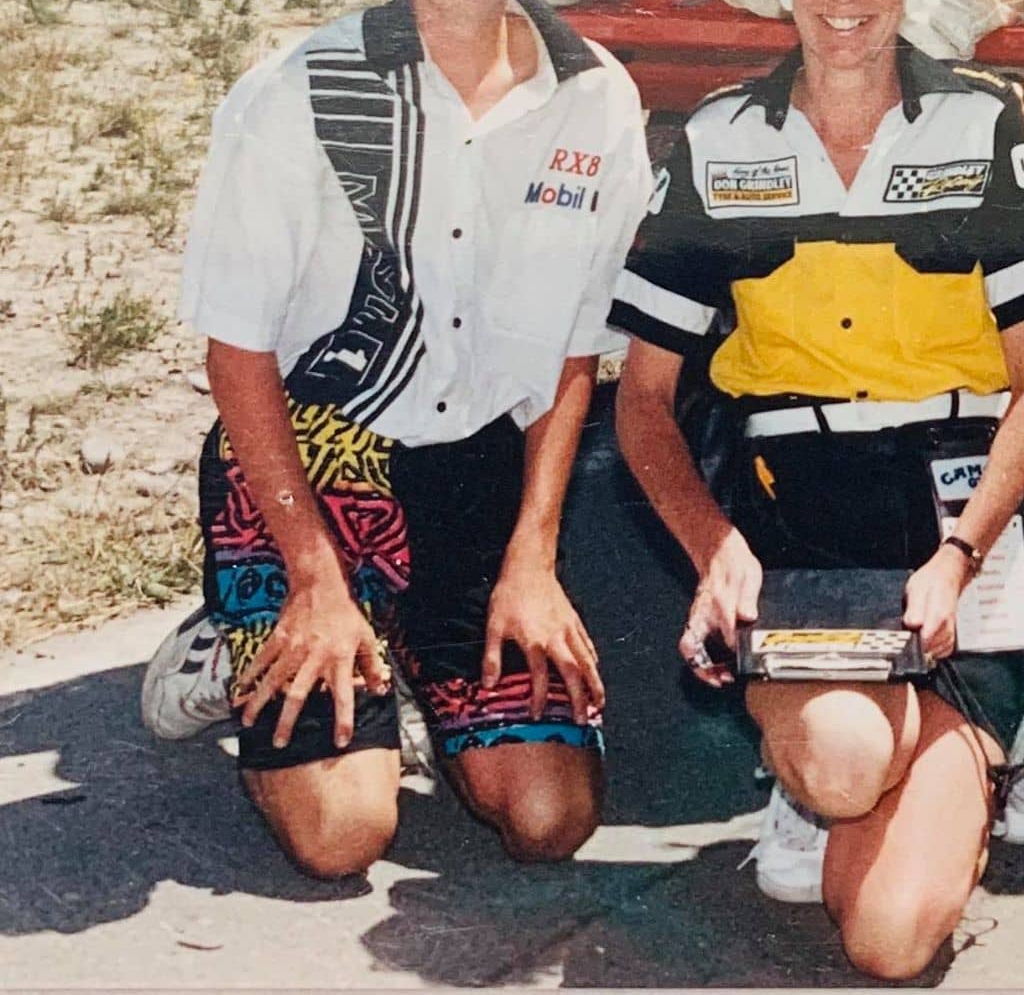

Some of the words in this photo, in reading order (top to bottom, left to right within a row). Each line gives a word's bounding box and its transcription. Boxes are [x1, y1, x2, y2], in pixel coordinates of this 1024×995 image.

[549, 148, 602, 178] RX8
[524, 181, 586, 210] Mobil
[940, 464, 984, 485] CAM
